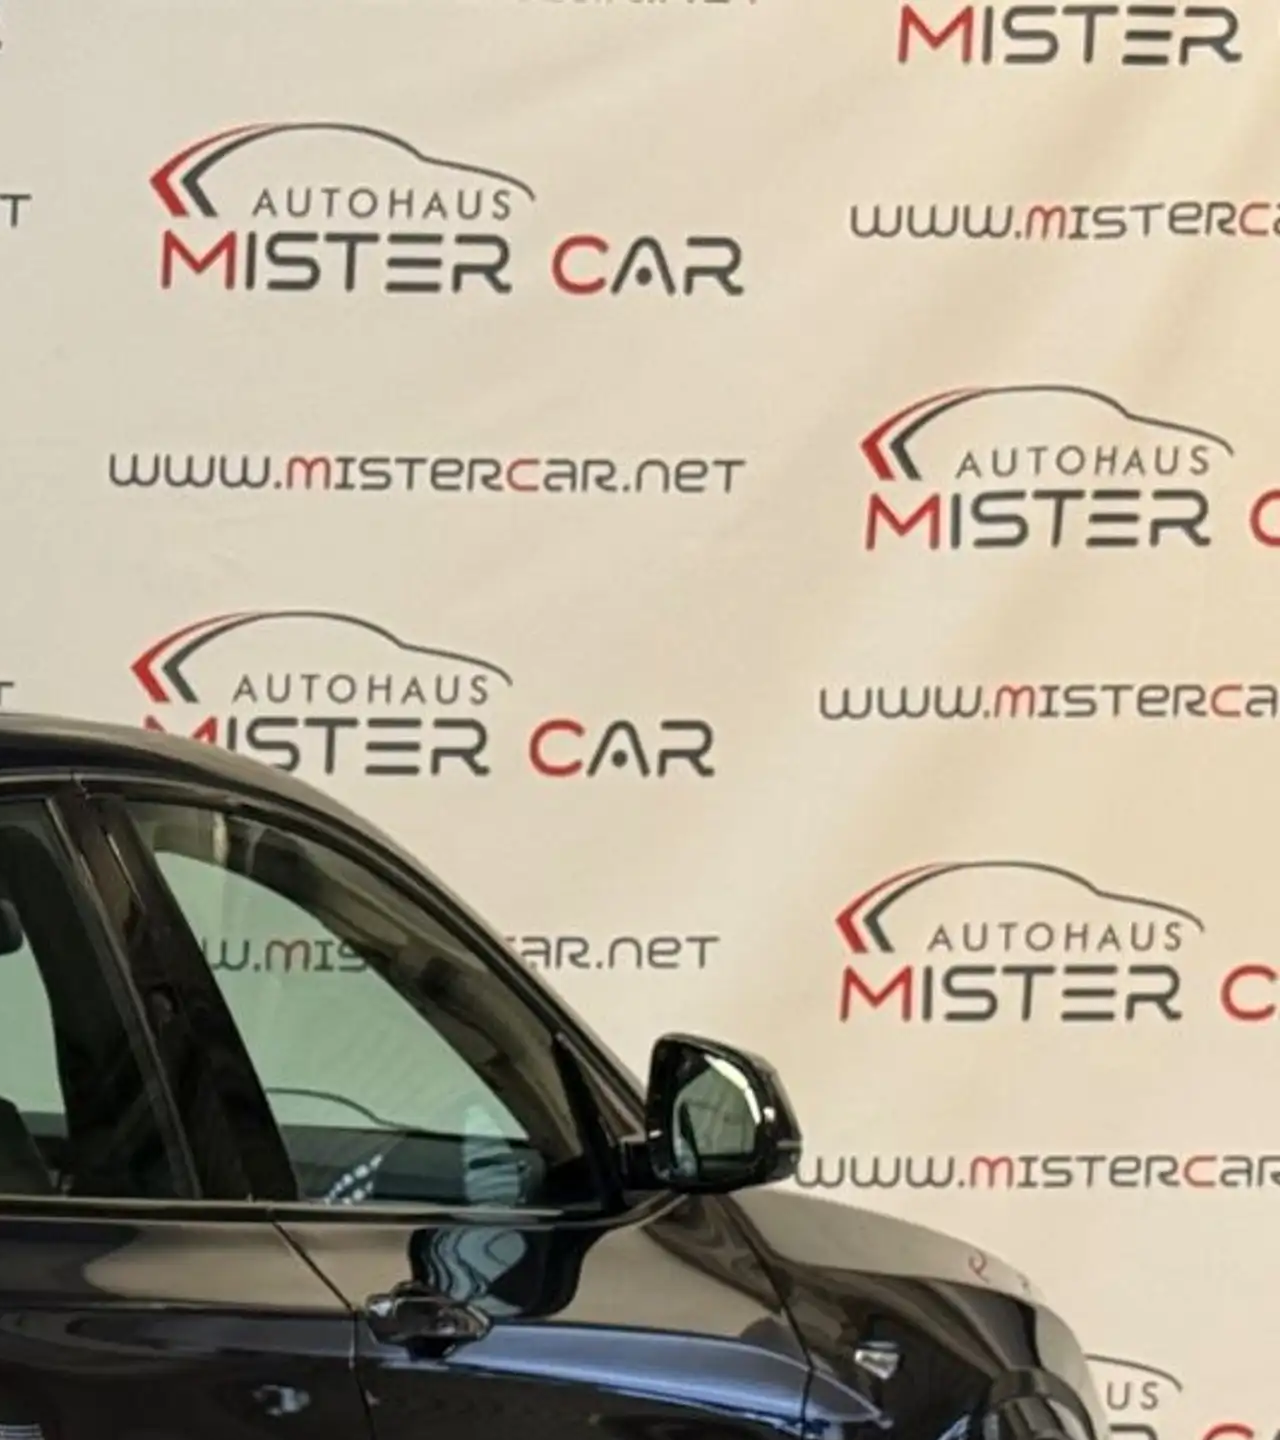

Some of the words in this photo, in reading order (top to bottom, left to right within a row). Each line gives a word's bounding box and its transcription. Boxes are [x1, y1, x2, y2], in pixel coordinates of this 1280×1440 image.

[896, 3, 1244, 67] MISTER
[250, 186, 512, 222] AUTOHAUS
[160, 228, 514, 295] MISTER
[550, 233, 746, 298] CAR
[954, 444, 1210, 480] AUTOHAUS
[864, 487, 1213, 552] MISTER
[231, 672, 489, 707] AUTOHAUS
[527, 717, 716, 779] CAR
[926, 920, 1183, 953] AUTOHAUS
[838, 963, 1184, 1025] MISTER
